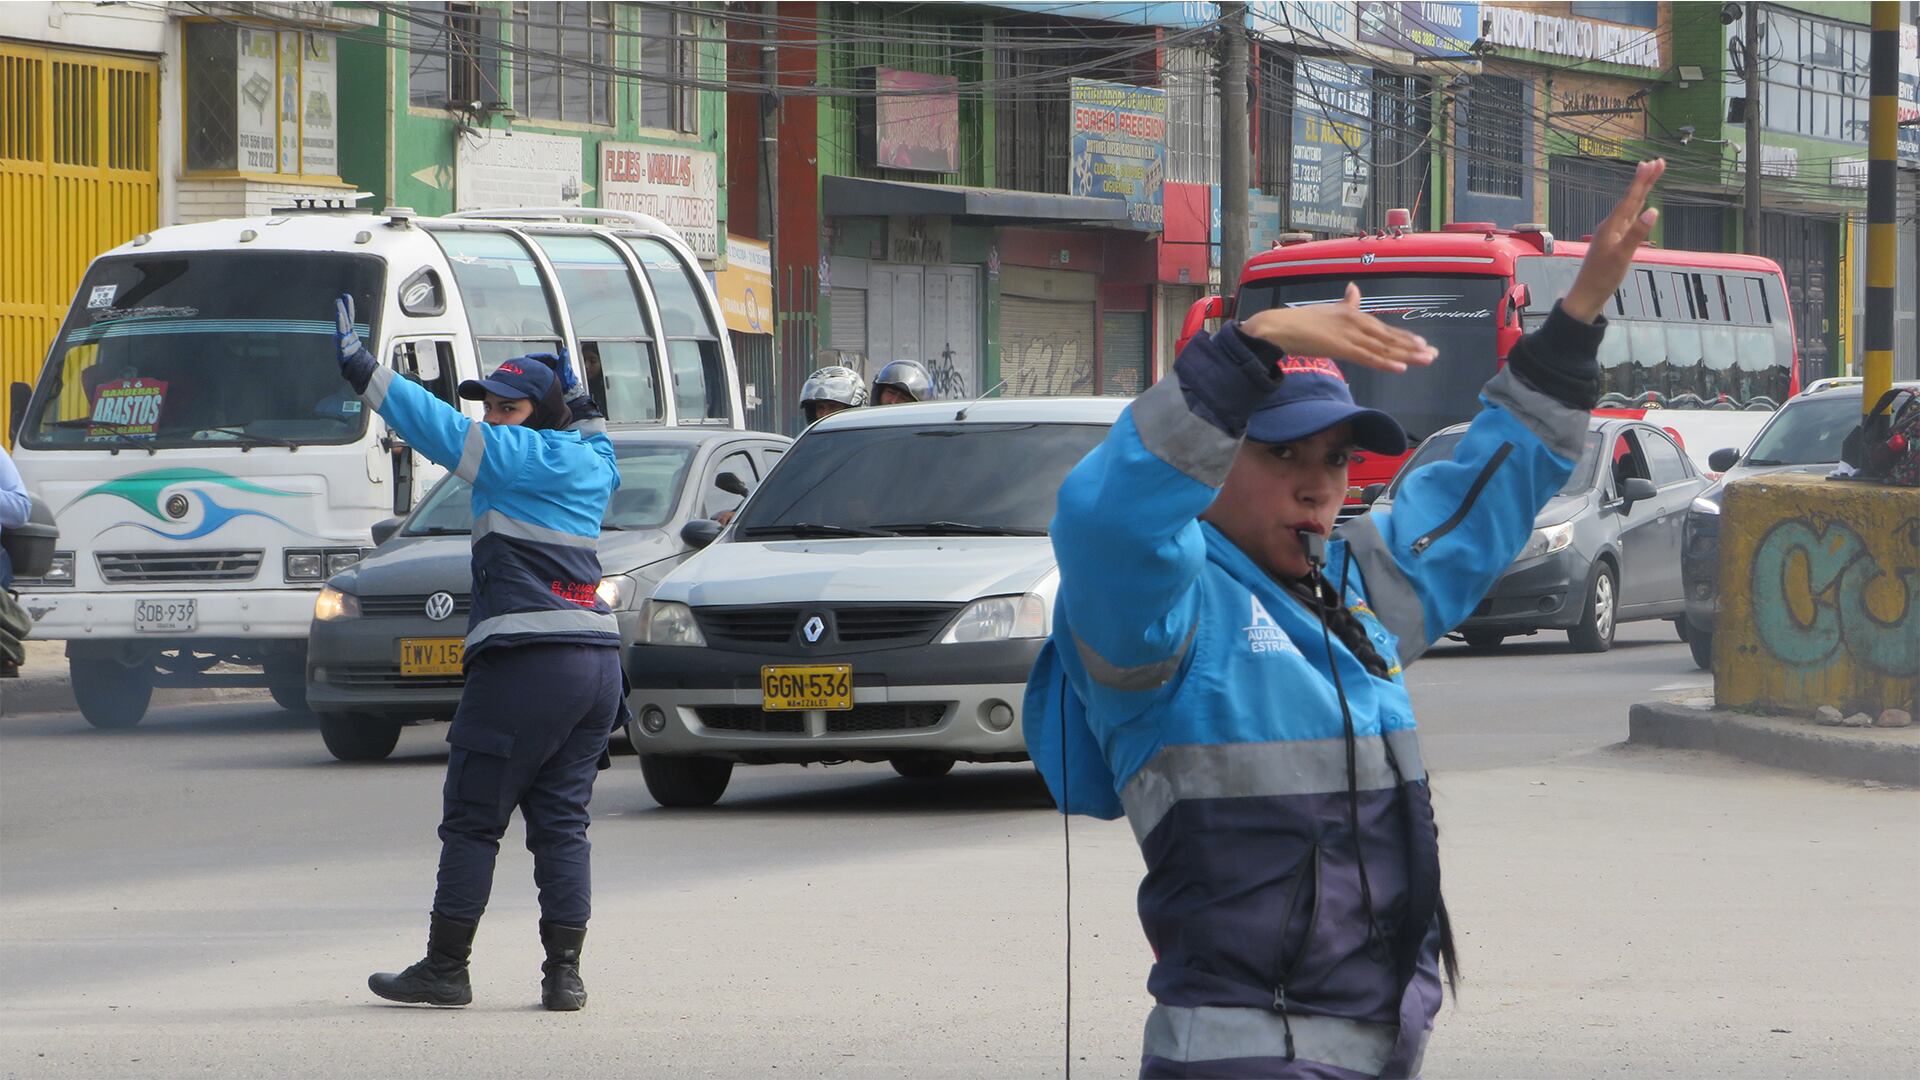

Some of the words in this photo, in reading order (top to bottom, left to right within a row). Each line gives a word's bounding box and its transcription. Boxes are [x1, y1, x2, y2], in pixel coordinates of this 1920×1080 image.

[1293, 2, 1348, 34] Miguel
[1427, 3, 1462, 28] LIVIANOS
[1537, 13, 1593, 58] TECNICO
[1597, 23, 1661, 68] MECANICA
[1306, 116, 1319, 143] EL
[605, 150, 641, 183] FLEJES
[646, 152, 692, 187] VARILLAS
[665, 195, 715, 229] LAVADEROS
[1402, 306, 1491, 321] Corriente
[404, 645, 433, 666] IWV
